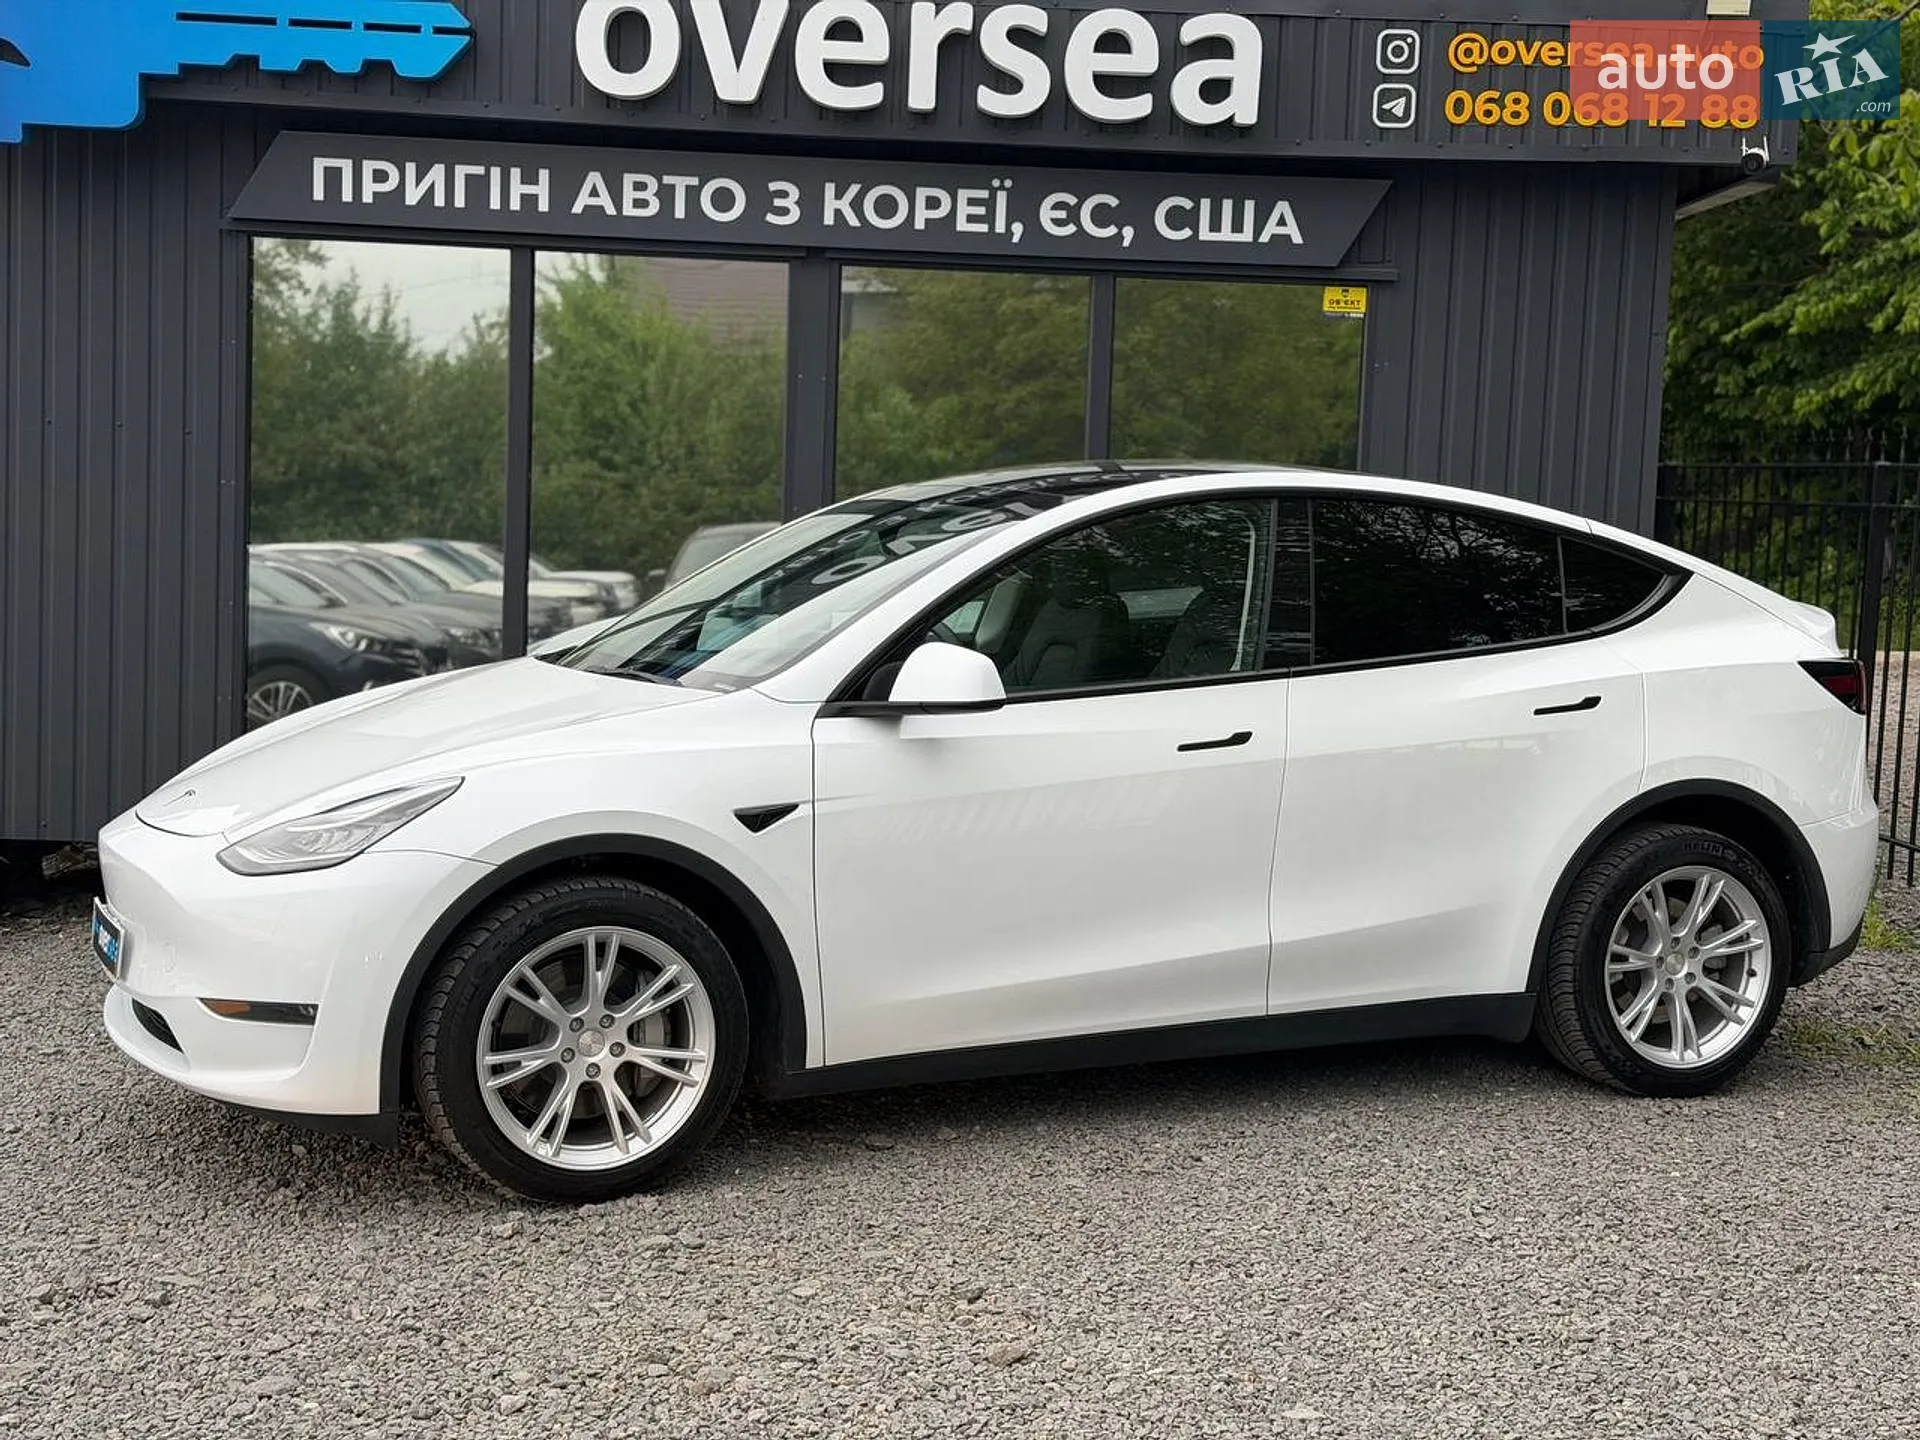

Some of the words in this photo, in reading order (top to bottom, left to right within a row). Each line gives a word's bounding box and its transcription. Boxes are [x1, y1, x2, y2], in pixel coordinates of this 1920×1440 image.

[575, 0, 1263, 126] oversea
[1445, 89, 1530, 126] 068
[1543, 91, 1629, 127] 068
[1644, 93, 1687, 128] 12
[1700, 94, 1760, 129] 88
[312, 157, 550, 213] ПРИГІН
[571, 171, 747, 222] АВТО
[764, 181, 801, 226] З
[823, 178, 1024, 243] КОРЕЇ,
[1039, 192, 1135, 248] ЄС,
[1154, 196, 1304, 245] США
